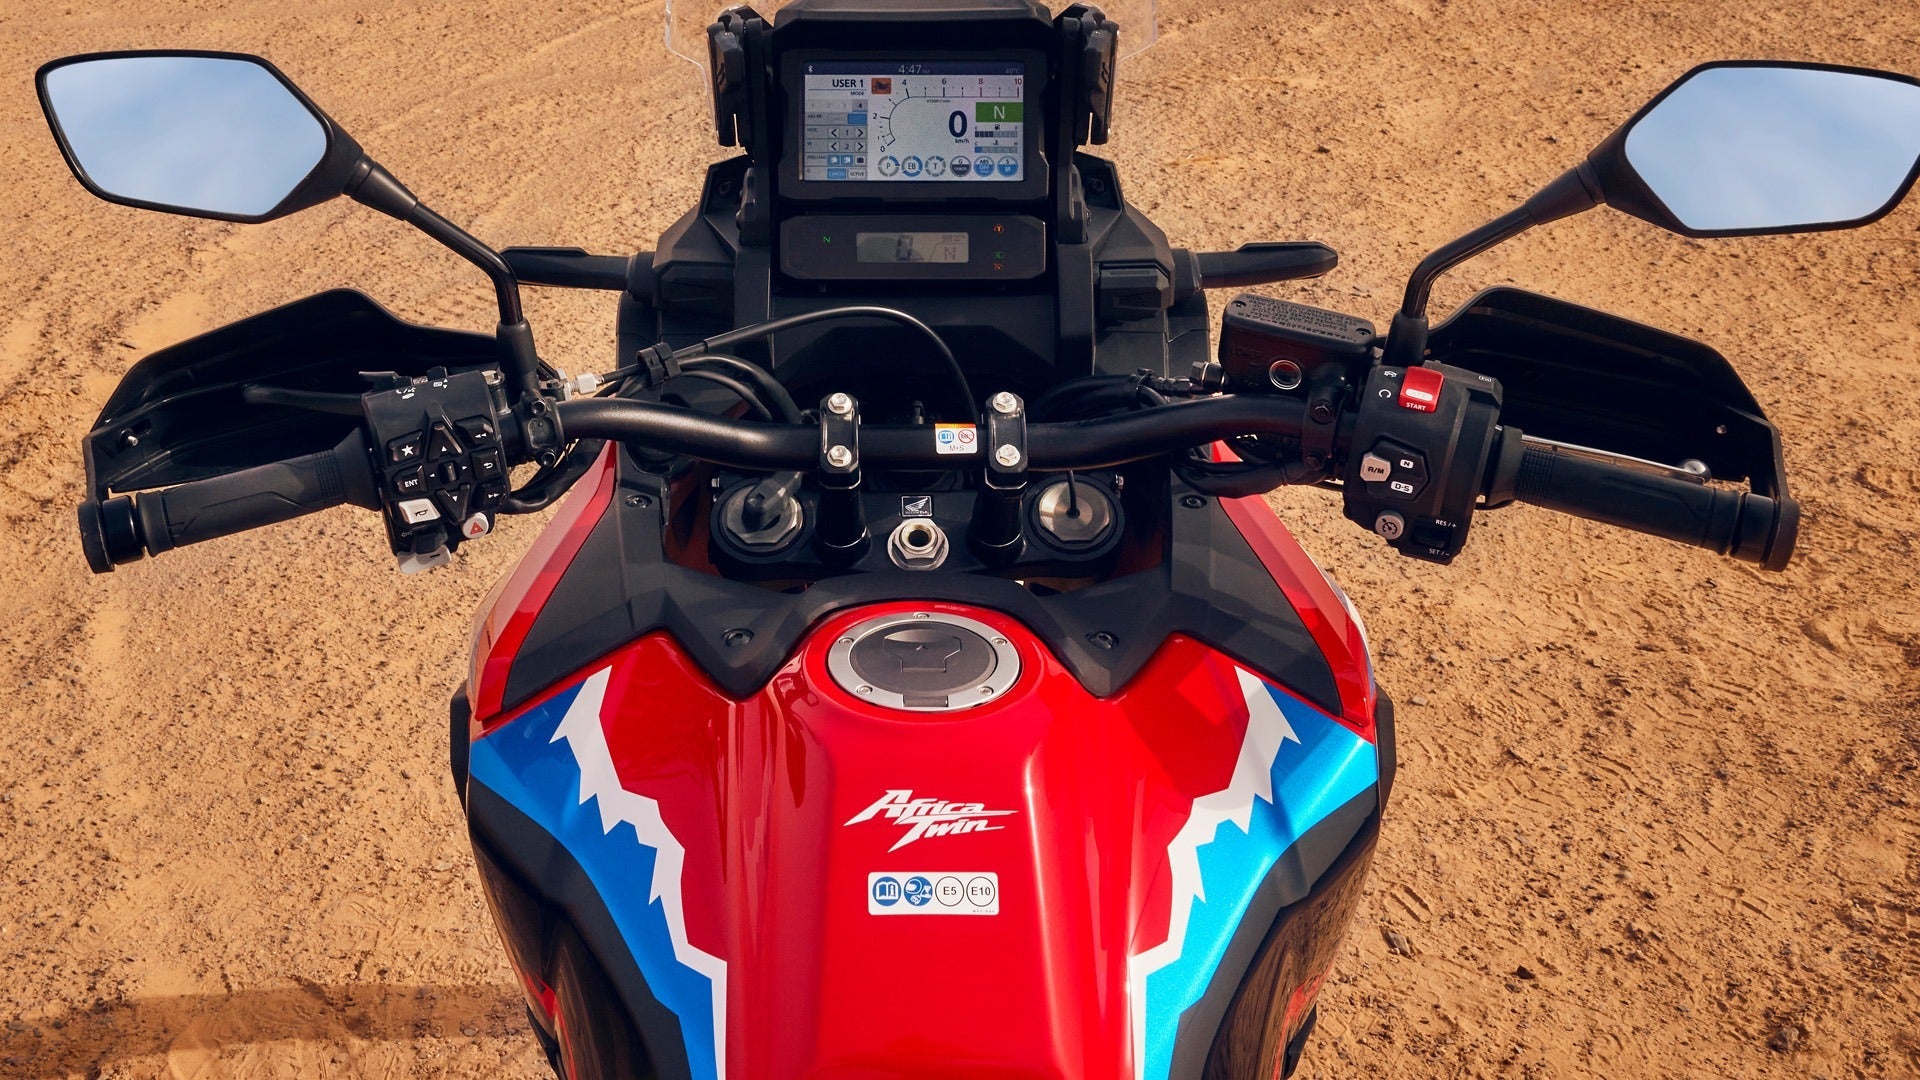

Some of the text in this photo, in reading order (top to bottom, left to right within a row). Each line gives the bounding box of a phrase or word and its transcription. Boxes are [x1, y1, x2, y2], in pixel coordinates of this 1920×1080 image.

[899, 65, 921, 73] 4:47
[832, 79, 864, 88] USER 1
[993, 105, 1006, 119] N
[949, 110, 968, 138] 0
[1406, 402, 1427, 411] START
[404, 479, 418, 488] ENT
[843, 789, 1019, 826] Africa
[887, 814, 1006, 853] Twin
[943, 886, 991, 896] E5 E10
